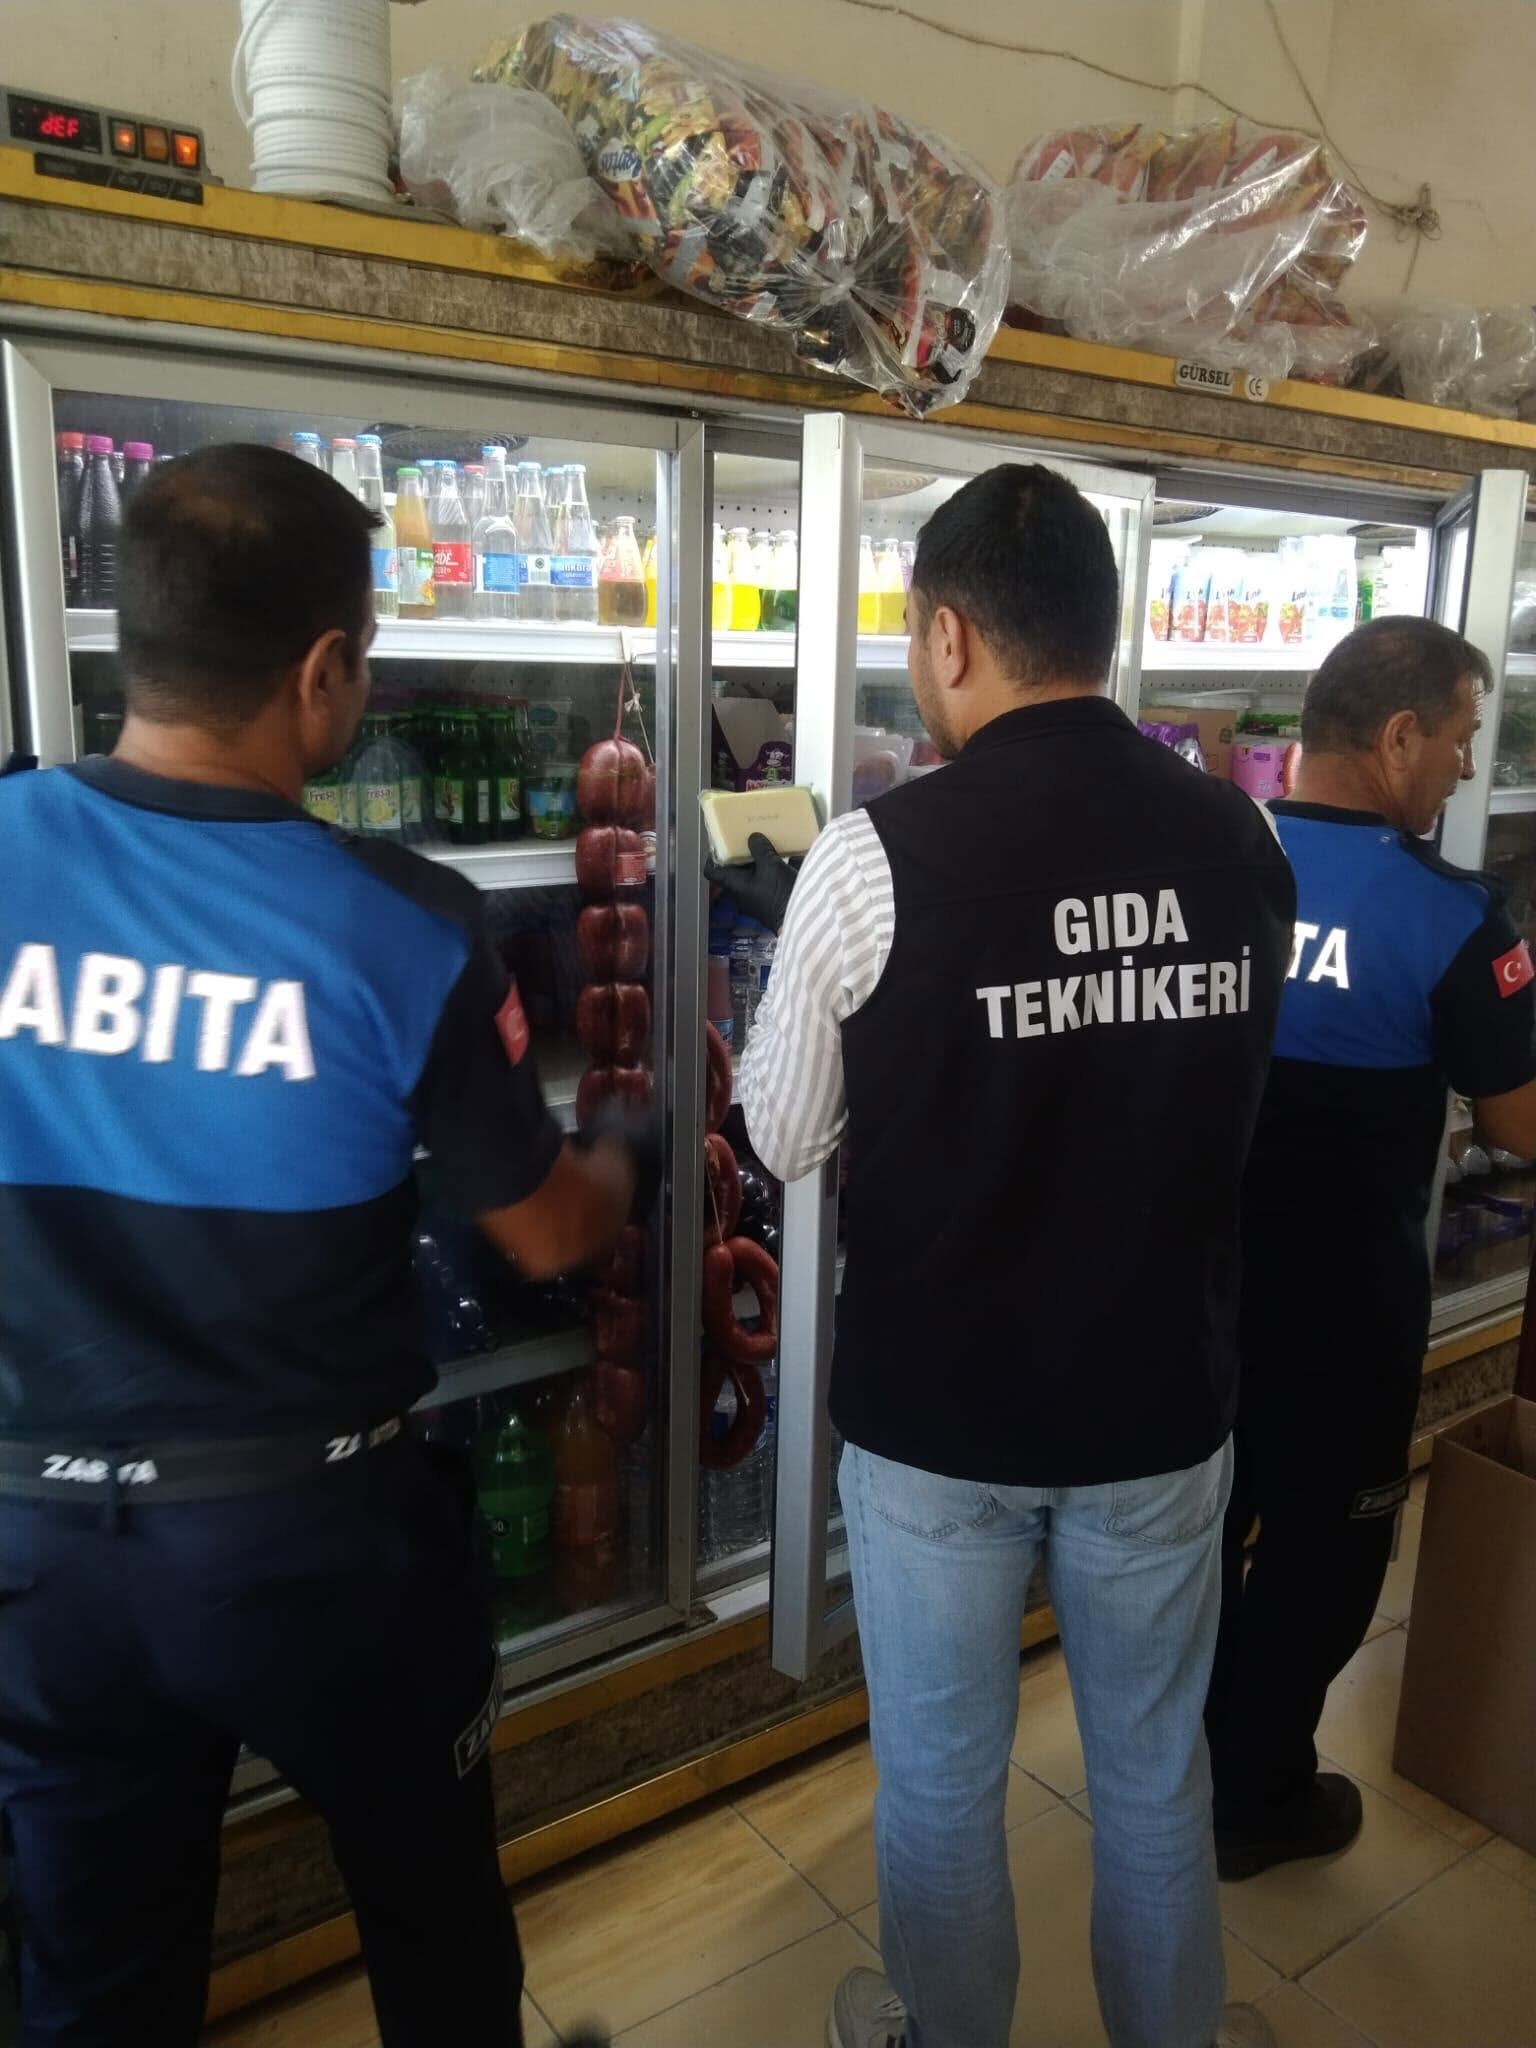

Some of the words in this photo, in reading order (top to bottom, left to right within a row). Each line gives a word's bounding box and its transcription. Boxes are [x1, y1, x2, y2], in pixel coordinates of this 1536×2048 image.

[1179, 362, 1232, 386] GÜRSEL
[1053, 888, 1190, 956] GIDA
[0, 942, 317, 1083] ABITA
[976, 945, 1252, 1039] TEKNİKERİ
